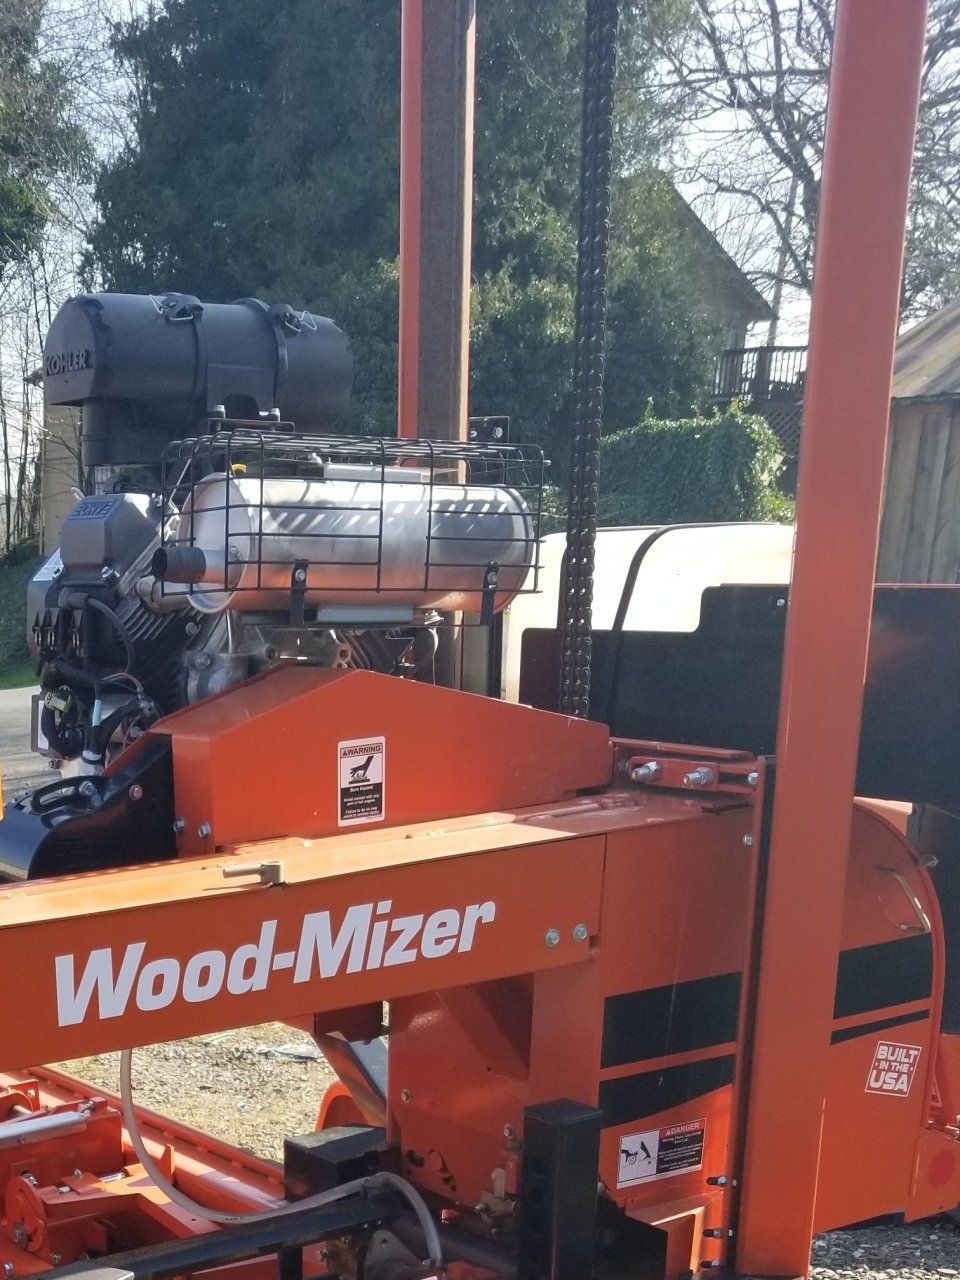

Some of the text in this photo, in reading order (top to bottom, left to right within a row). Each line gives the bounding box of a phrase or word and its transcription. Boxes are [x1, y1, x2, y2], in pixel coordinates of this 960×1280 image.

[44, 350, 87, 376] KOHLER
[347, 745, 381, 755] WARNING
[55, 899, 496, 1027] Wood-Mizer
[876, 1045, 919, 1063] BUILT
[879, 1060, 909, 1073] IN THE
[869, 1069, 908, 1093] USA
[670, 1122, 700, 1135] DANGER
